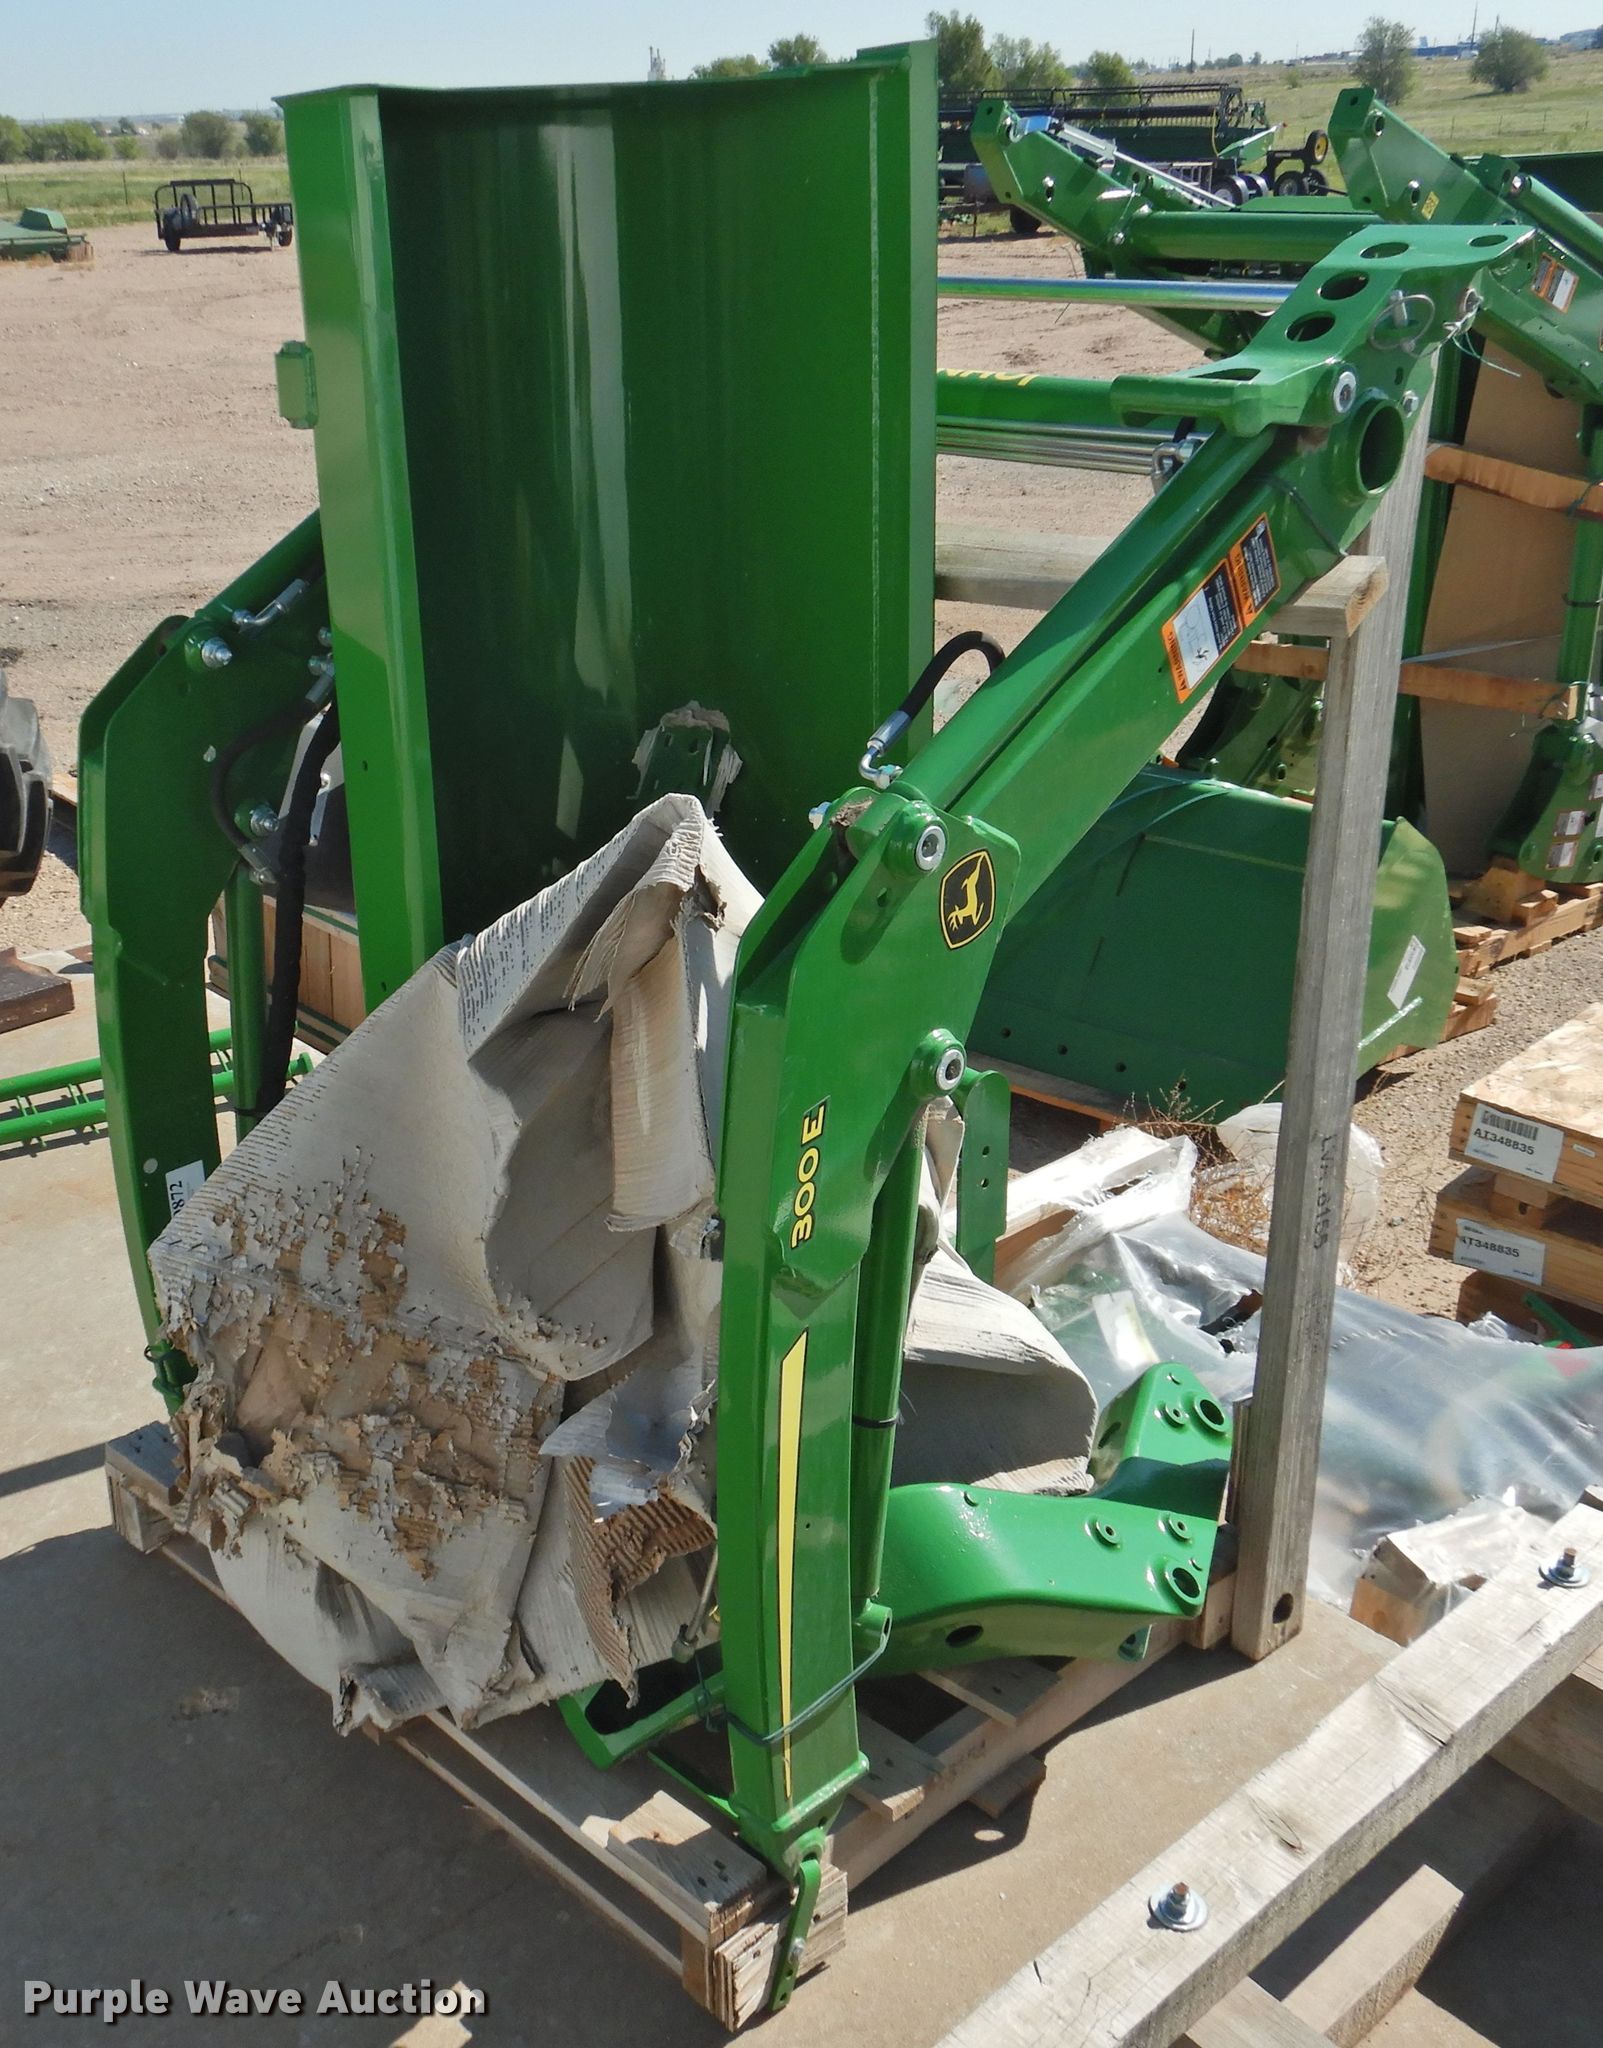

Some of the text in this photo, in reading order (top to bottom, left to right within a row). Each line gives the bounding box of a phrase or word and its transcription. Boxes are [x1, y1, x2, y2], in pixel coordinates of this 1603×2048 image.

[1235, 552, 1253, 601] WARNING
[1168, 630, 1186, 682] WARNING
[790, 1100, 828, 1249] 300E
